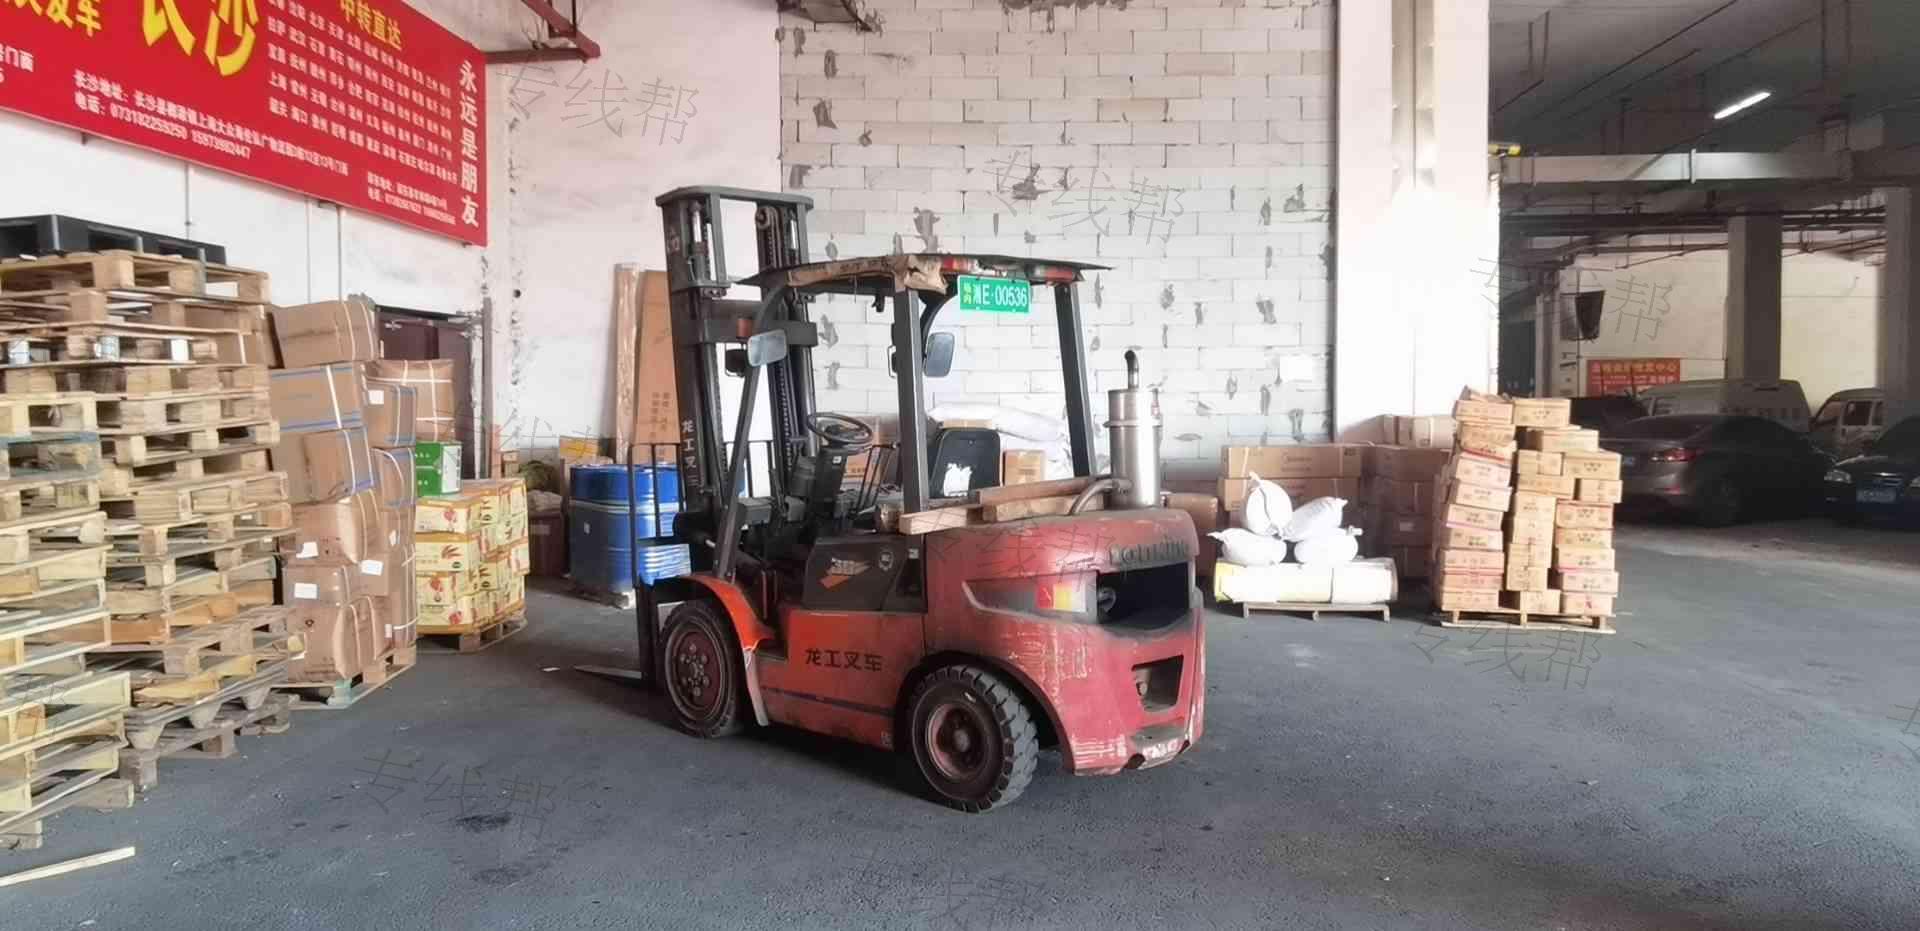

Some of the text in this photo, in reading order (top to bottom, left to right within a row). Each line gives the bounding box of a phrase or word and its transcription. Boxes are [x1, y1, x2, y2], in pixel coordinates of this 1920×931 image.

[340, 0, 402, 51] 中转直达
[459, 60, 480, 227] 永远是朋友
[804, 647, 883, 672] 龙工叉车
